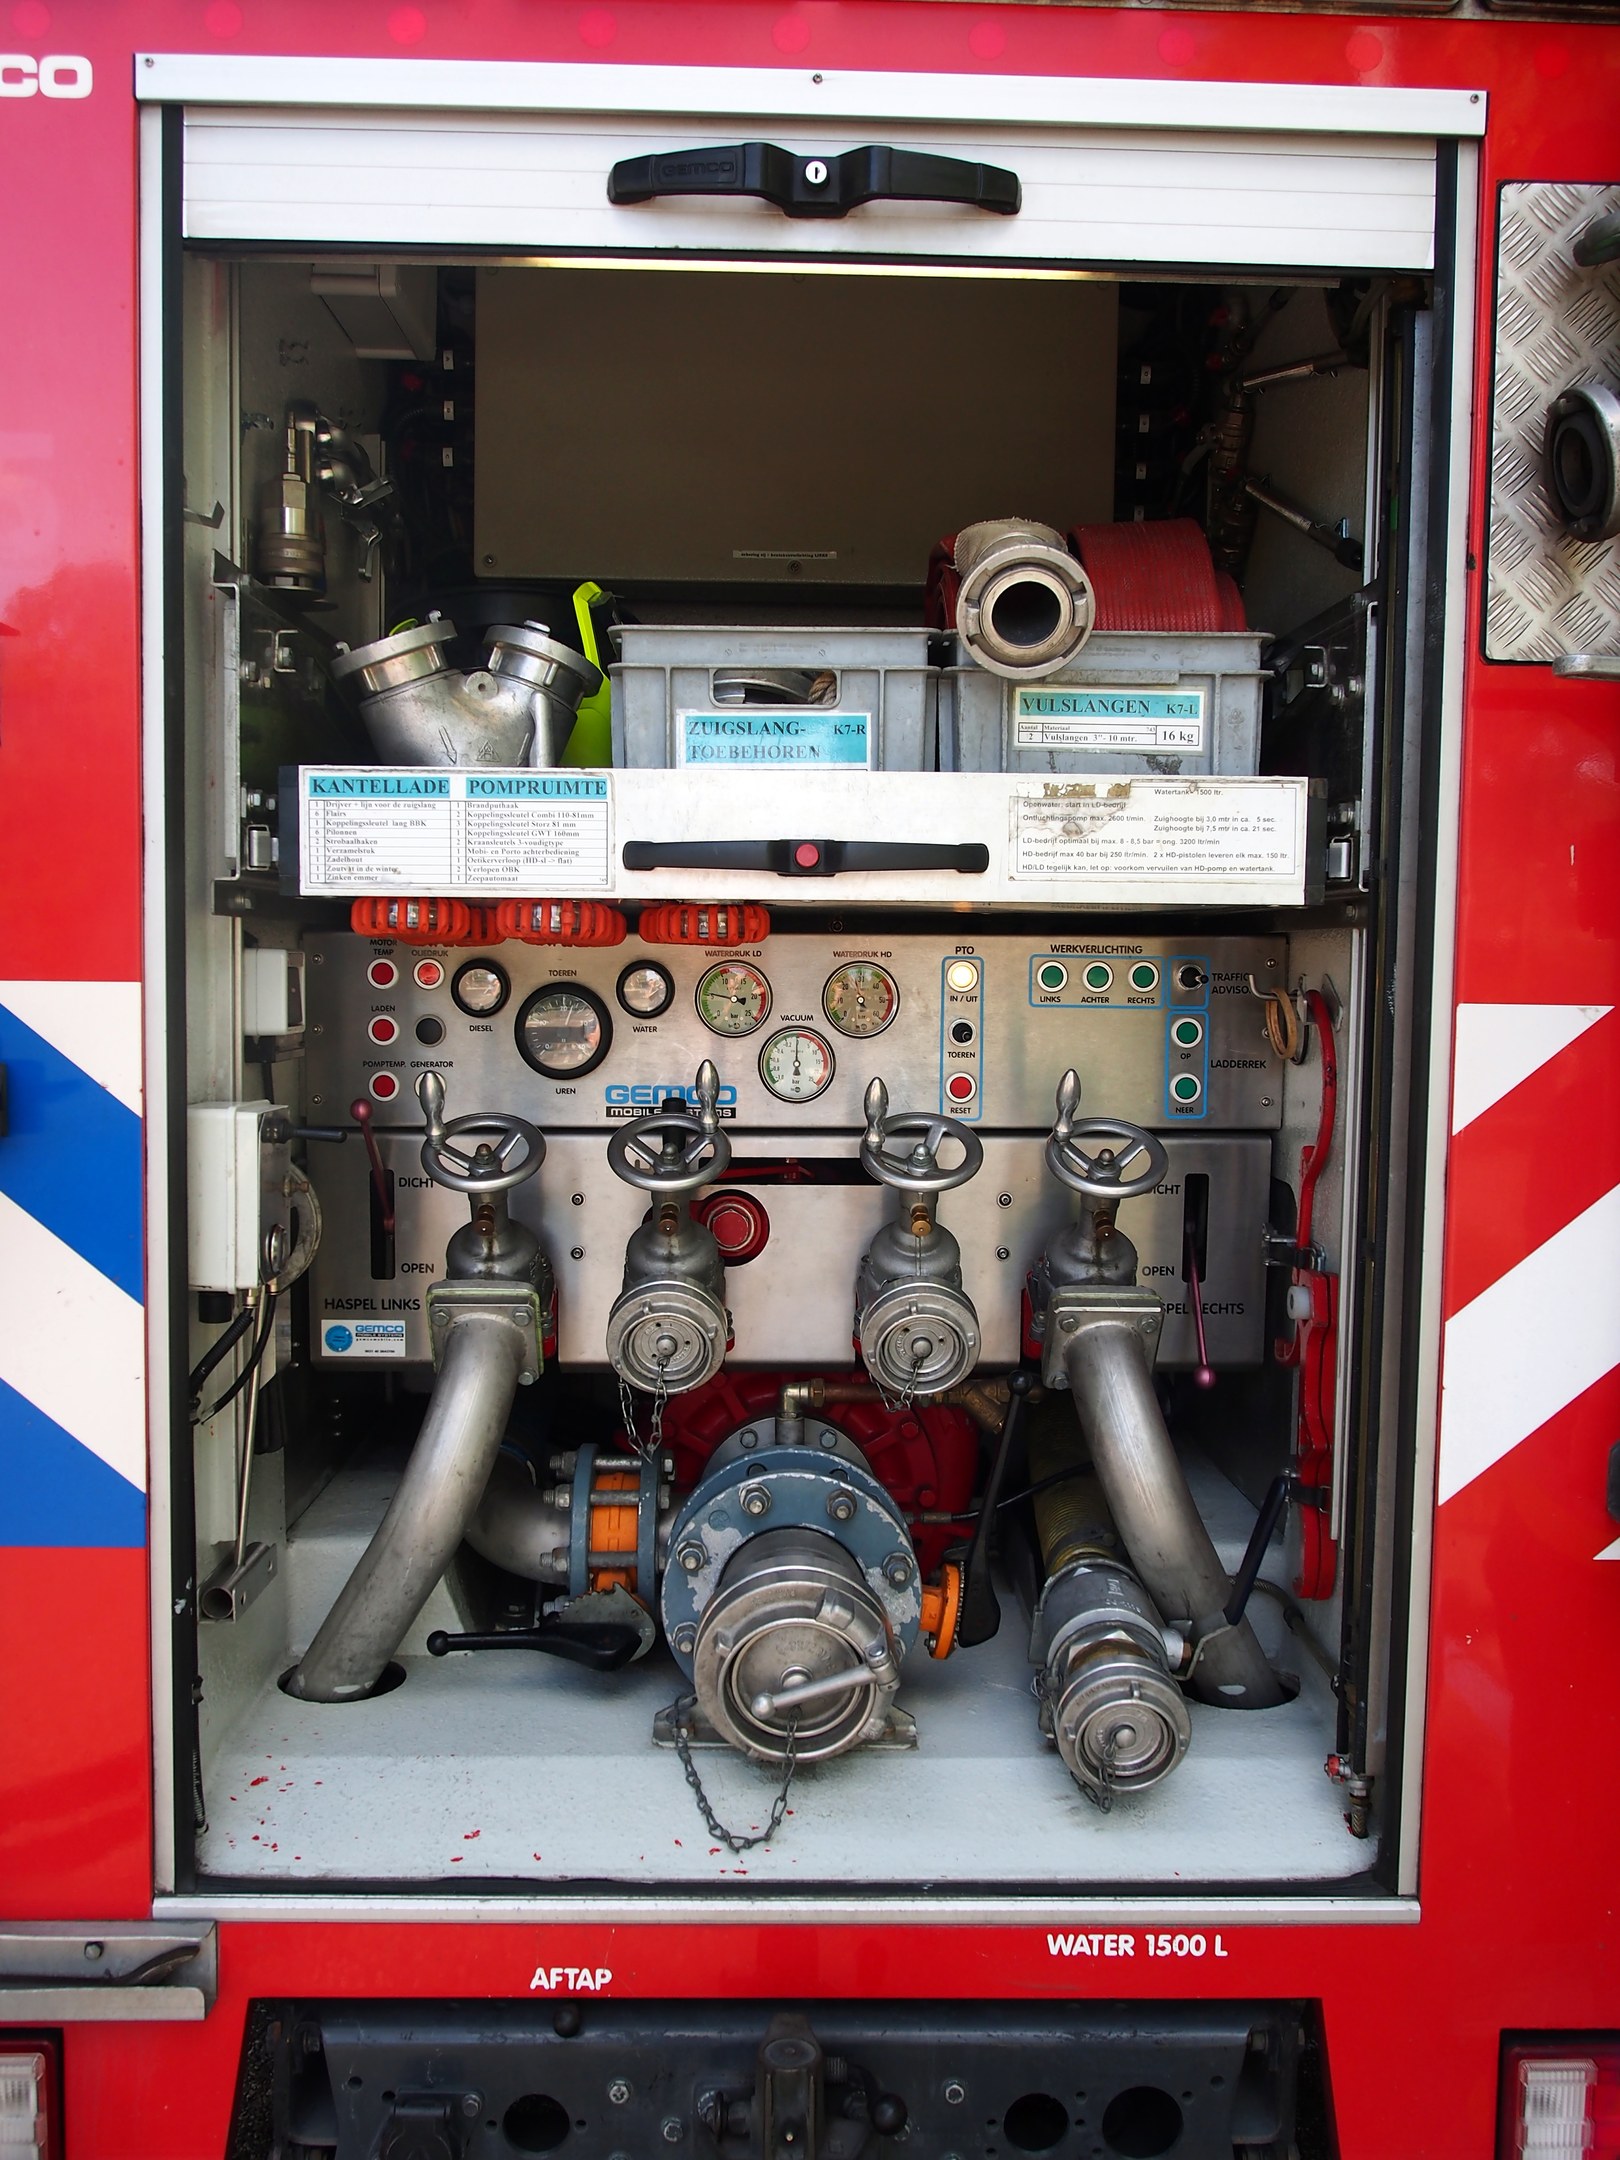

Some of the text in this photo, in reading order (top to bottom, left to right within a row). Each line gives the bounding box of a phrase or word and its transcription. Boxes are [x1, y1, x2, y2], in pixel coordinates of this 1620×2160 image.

[662, 161, 734, 177] GEMCO
[1022, 698, 1198, 715] VULSLANGEN K7-L
[688, 721, 866, 736] ZUIGSLANG- K7-R
[1044, 733, 1089, 743] Vulslangen
[1162, 730, 1176, 741] 16
[1179, 730, 1194, 743] kg
[688, 745, 820, 759] TOEBEHOREN
[312, 779, 607, 795] KANTELLADE POMPRUIMTE
[326, 801, 352, 809] Drijver
[403, 802, 436, 810] zuigslang
[467, 802, 519, 810] Brandputhaak
[1153, 816, 1194, 824] Zuighoogte
[1153, 825, 1194, 833] Zuighoogte
[467, 875, 518, 884] Zeepautomaat
[373, 948, 394, 956] TEMP
[411, 949, 449, 957] OLIEDRUK
[955, 946, 975, 955] PTO
[1050, 944, 1143, 955] WERKVERLICHTING
[705, 950, 751, 958] WATERDRUK
[833, 950, 879, 958] WATERDRUK
[548, 969, 577, 977] TOEREN
[1212, 973, 1250, 981] TRAFFIC
[1212, 985, 1251, 994] ADVISO
[949, 995, 959, 1003] IN
[965, 995, 978, 1003] UIT
[1039, 996, 1155, 1004] LINKS ACHTER RECHTS
[371, 1005, 396, 1013] LADEN
[780, 1014, 814, 1022] VACUUM
[469, 1025, 493, 1033] DIESEL
[632, 1025, 658, 1033] WATER
[947, 1051, 976, 1059] TOEREN
[1180, 1053, 1191, 1061] OP
[362, 1060, 454, 1068] POMPTEMP. GENERATOR
[1210, 1060, 1267, 1069] LADDERREK
[555, 1087, 576, 1095] UREN
[950, 1107, 972, 1115] RESET
[1175, 1106, 1194, 1114] NEER
[399, 1177, 434, 1188] DICHT
[1148, 1184, 1181, 1194] ICHT
[401, 1263, 434, 1274] OPEN
[1142, 1266, 1175, 1276] OPEN
[324, 1299, 421, 1311] HASPEL LINKS
[1203, 1303, 1245, 1314] ECHTS
[355, 1325, 404, 1333] GEMCO
[1047, 1933, 1228, 1958] WATER 1500 L
[530, 1967, 613, 1992] AFTAP
